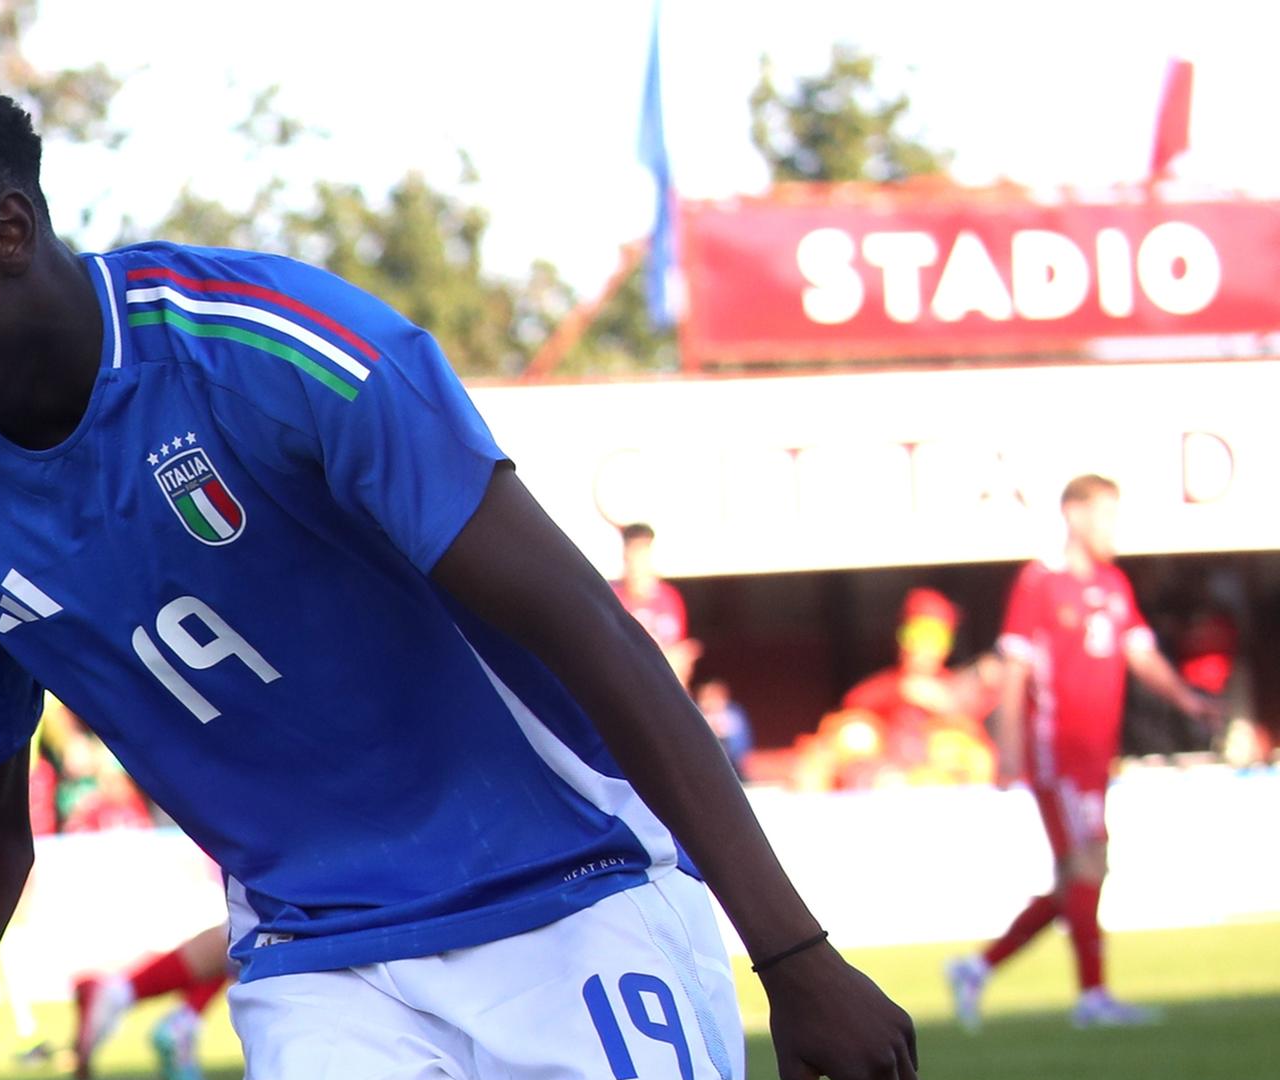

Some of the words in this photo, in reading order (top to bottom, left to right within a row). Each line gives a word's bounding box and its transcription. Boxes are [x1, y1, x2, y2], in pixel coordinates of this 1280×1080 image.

[796, 220, 1221, 324] STADIO
[160, 456, 209, 492] ITALIA
[132, 595, 282, 725] 19
